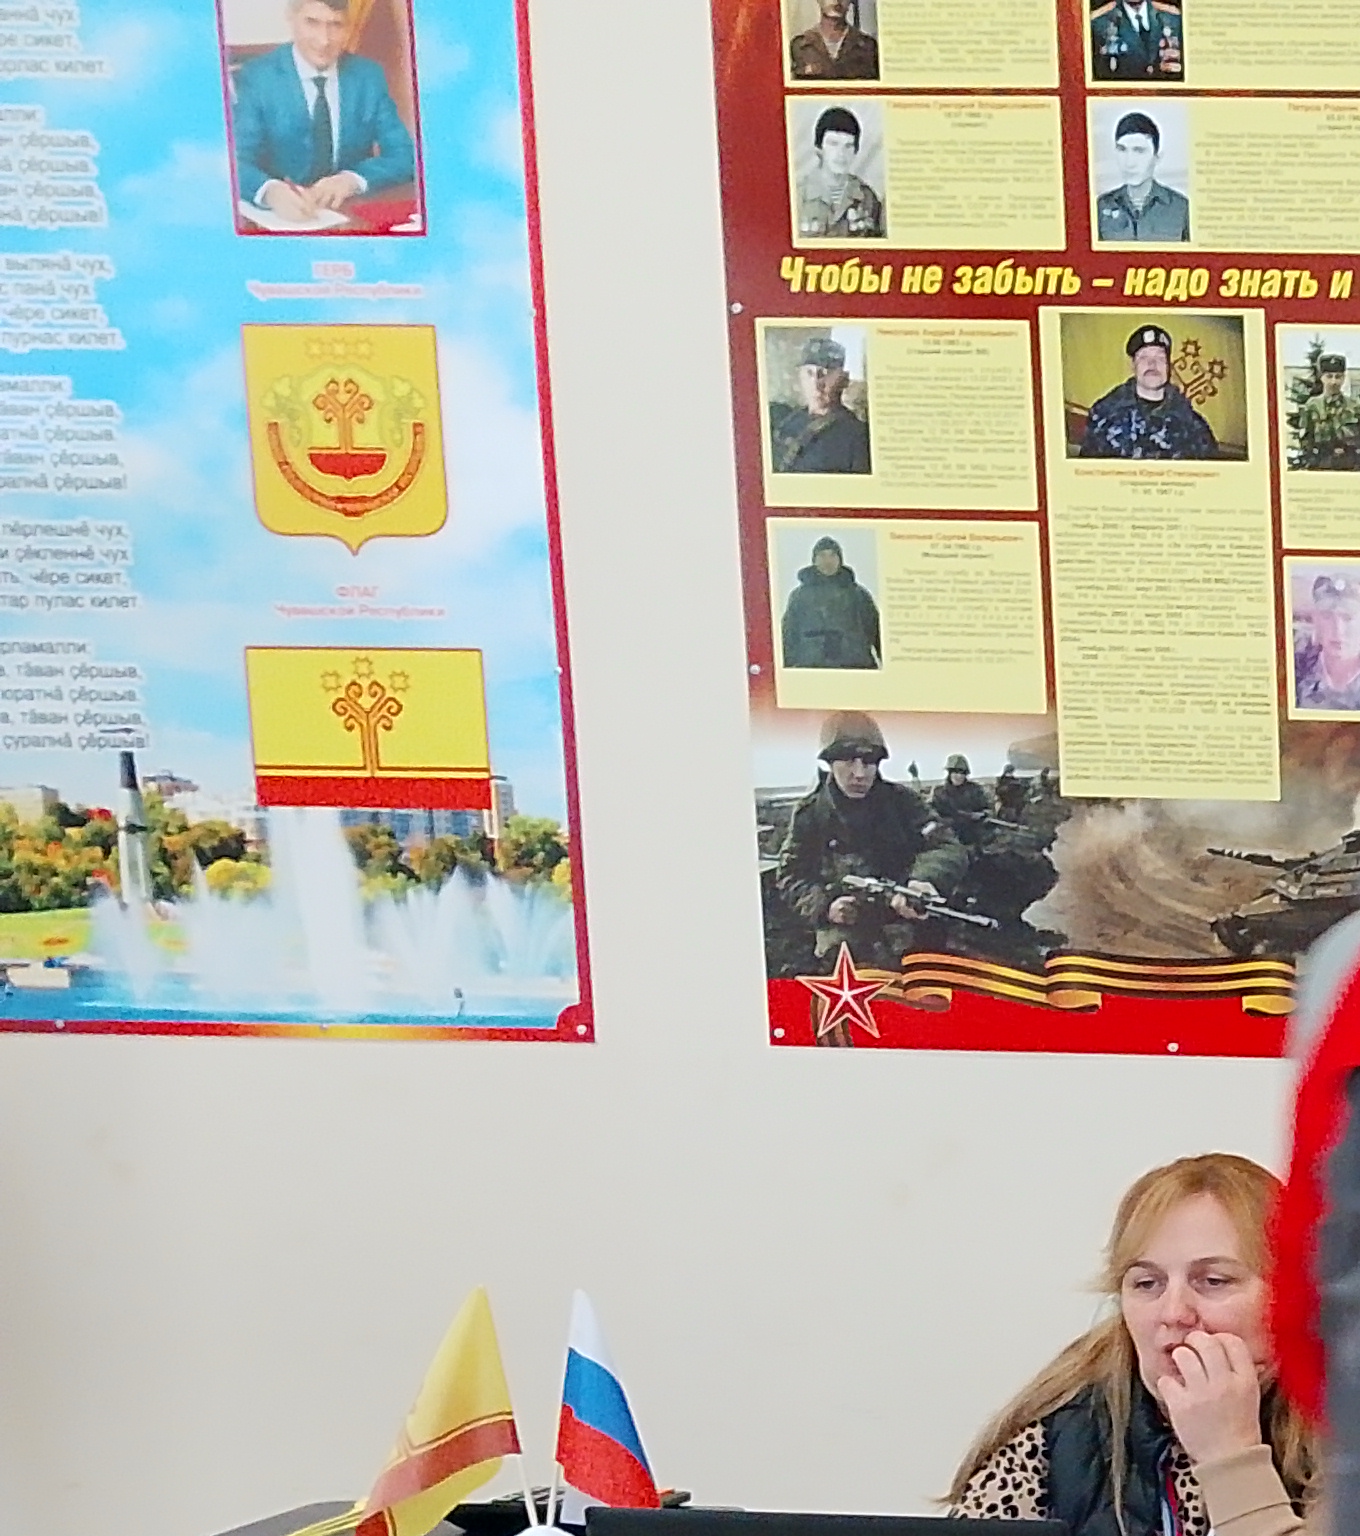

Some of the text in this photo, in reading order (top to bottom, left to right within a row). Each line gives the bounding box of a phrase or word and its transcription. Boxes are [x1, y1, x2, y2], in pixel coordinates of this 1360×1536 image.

[779, 255, 892, 293] Чтобы
[900, 263, 944, 293] не
[951, 258, 1081, 296] забыть
[1123, 267, 1210, 301] надо
[1219, 268, 1318, 299] знать
[1329, 270, 1353, 299] и
